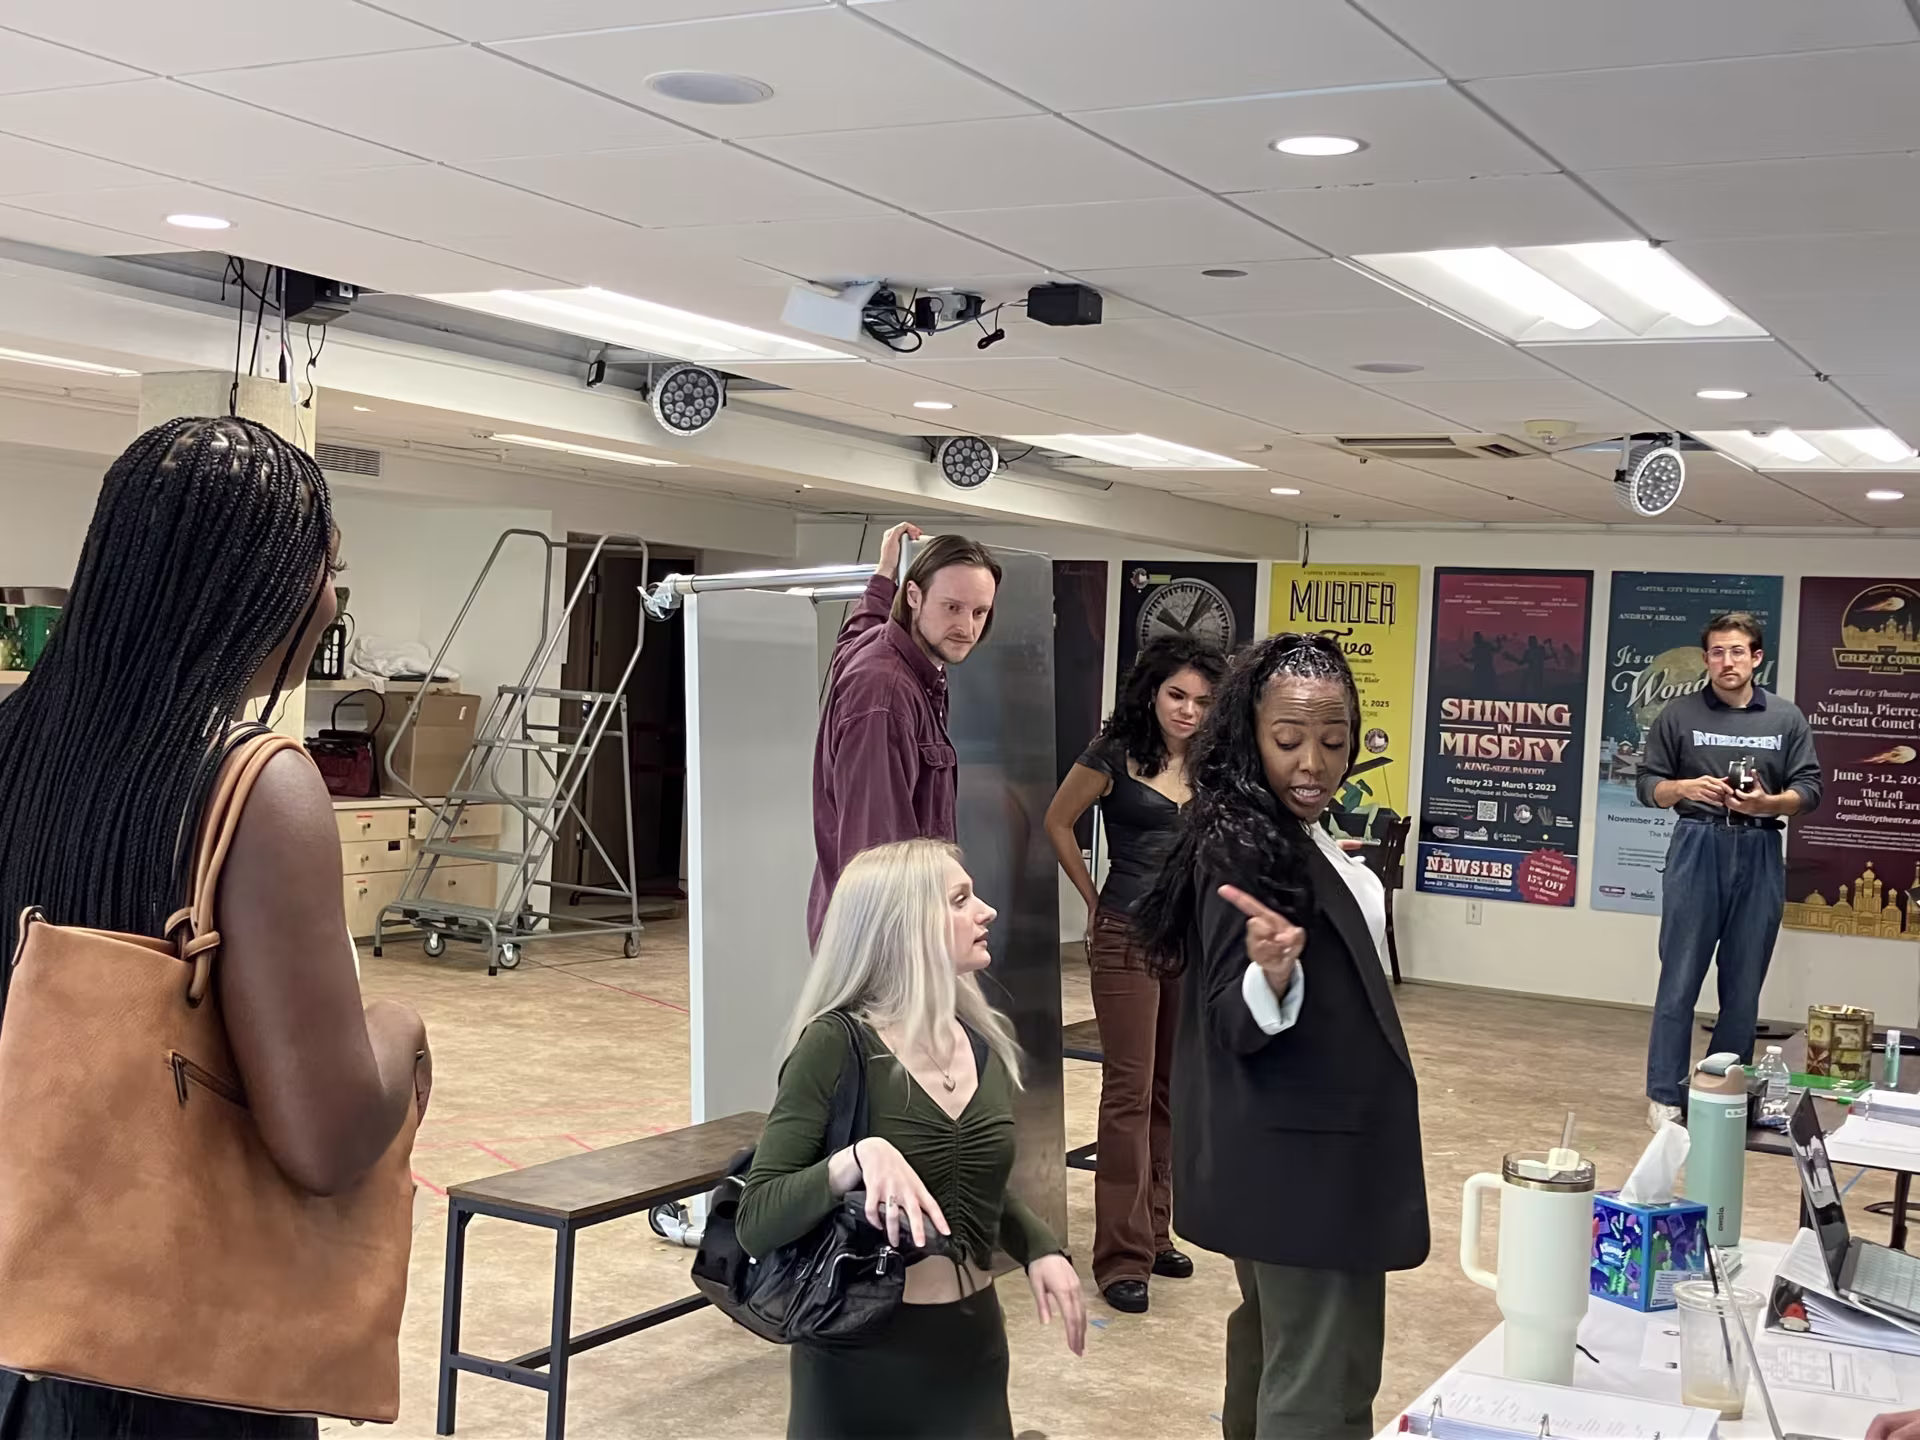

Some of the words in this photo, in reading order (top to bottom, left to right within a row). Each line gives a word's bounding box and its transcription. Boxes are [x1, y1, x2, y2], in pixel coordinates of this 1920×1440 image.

[1290, 580, 1397, 625] MURDER
[1612, 645, 1641, 667] It's
[1644, 654, 1654, 664] a
[1839, 653, 1885, 664] GREAT
[1860, 689, 1876, 698] City
[1878, 689, 1909, 698] Theatre
[1440, 698, 1572, 727] SHINING
[1808, 713, 1828, 725] the
[1832, 715, 1868, 727] Great
[1872, 717, 1914, 730] Comet
[1498, 724, 1512, 734] IN
[1439, 732, 1571, 763] MISERY
[1463, 762, 1511, 773] KING-SIZE
[1513, 766, 1546, 775] PARODY
[1833, 769, 1863, 782] June
[1446, 776, 1481, 787] February
[1482, 779, 1493, 787] 23
[1502, 781, 1526, 790] March
[1528, 782, 1533, 790] 5
[1535, 783, 1556, 792] 2023
[1465, 788, 1494, 797] Playhouse
[1861, 788, 1880, 798] The
[1883, 790, 1903, 799] Loft
[1837, 797, 1862, 807] Four
[1864, 799, 1896, 809] Winds
[1608, 814, 1651, 825] November
[1654, 818, 1665, 826] 22
[1426, 856, 1512, 878] NEWSIES
[1545, 880, 1567, 891] OFF
